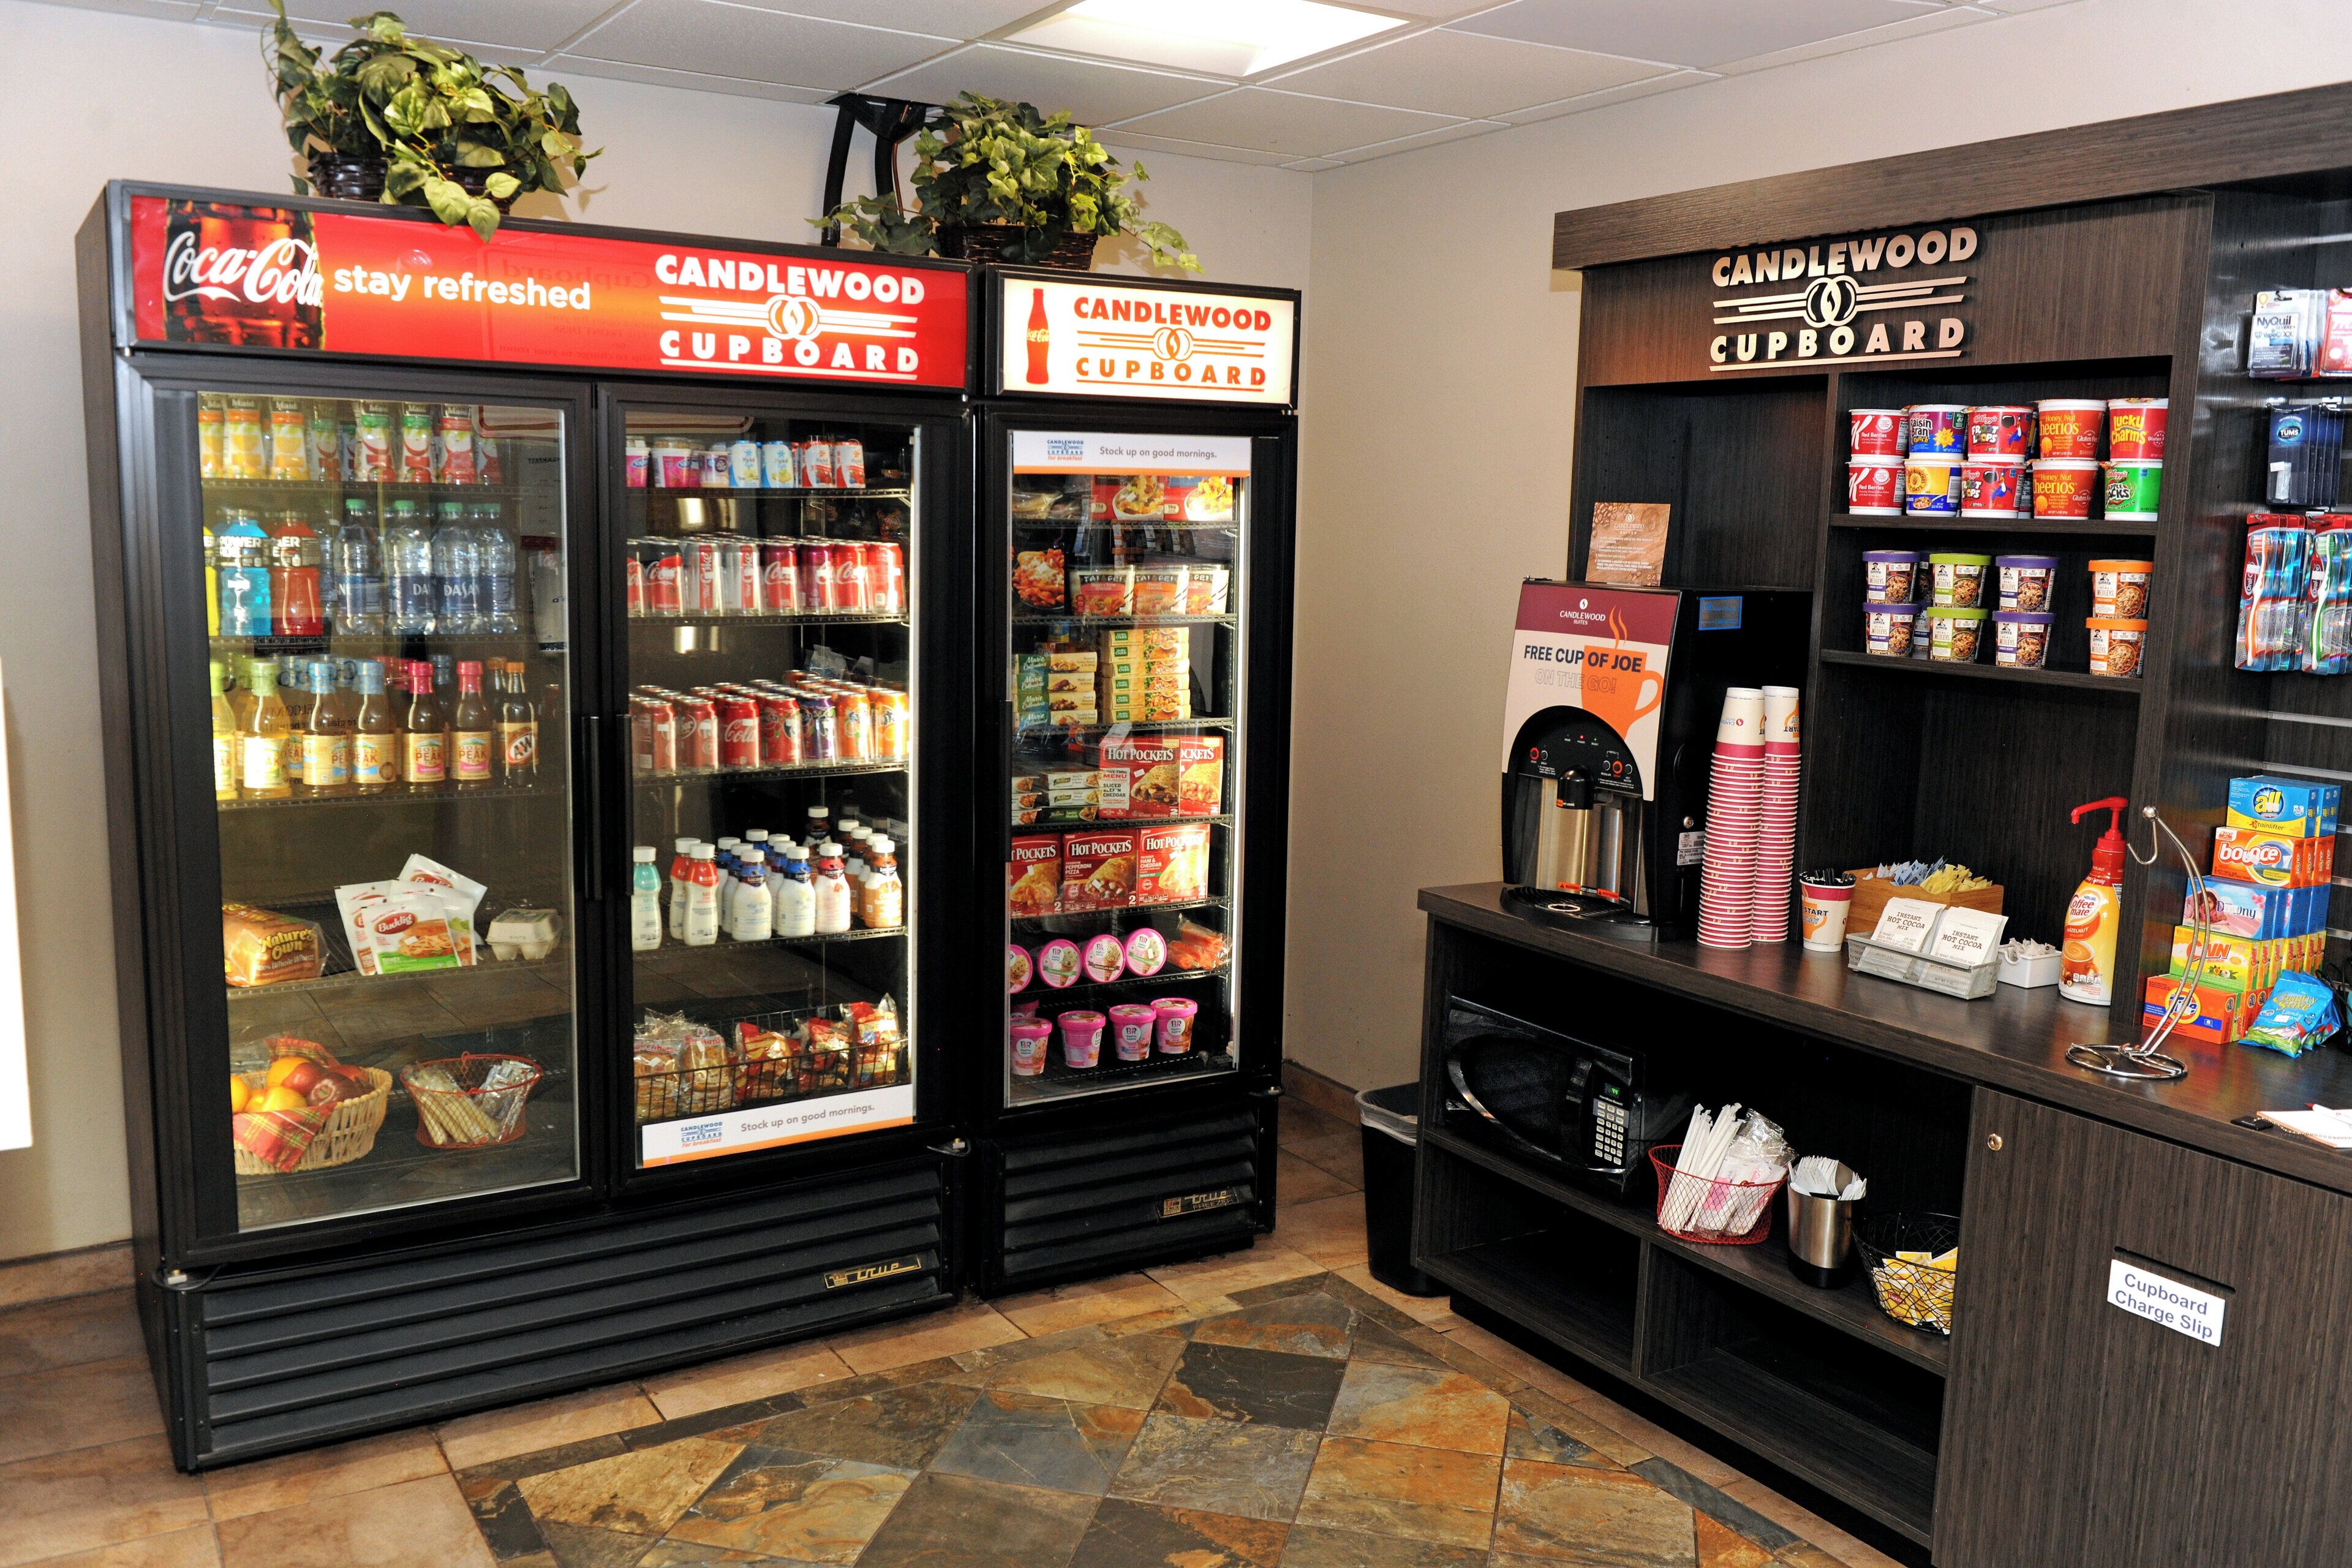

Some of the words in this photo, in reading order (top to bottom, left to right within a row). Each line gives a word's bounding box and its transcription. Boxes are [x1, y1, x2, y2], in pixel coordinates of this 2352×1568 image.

[1713, 227, 1977, 287] CANDLEWOOD
[162, 231, 324, 307] Coca-Cola
[655, 254, 925, 305] CANDLEWOOD
[334, 264, 412, 301] stay
[423, 272, 590, 311] refreshed
[1074, 297, 1271, 331] CANDLEWOOD
[2257, 316, 2291, 328] NyQuil
[1710, 317, 1964, 363] CUPBOARD
[659, 330, 919, 372] CUPBOARD
[1076, 357, 1266, 385] CUPBOARD
[1910, 419, 1931, 428] Raisin
[1973, 414, 1997, 424] Kellogg's
[2114, 415, 2144, 431] LUCKY
[2111, 429, 2147, 445] Charms
[1100, 447, 1123, 456] Stock
[1125, 448, 1137, 458] up
[1153, 448, 1174, 459] good
[1177, 449, 1217, 459] mornings.
[1560, 611, 1605, 621] CANDLEWOOD
[1524, 645, 1553, 661] FREE
[1556, 649, 1584, 664] CUP
[1588, 652, 1608, 667] OF
[1611, 654, 1642, 673] JOE
[1536, 668, 1554, 685] ON
[1558, 671, 1583, 688] THE
[1588, 676, 1616, 693] GO!
[416, 752, 443, 761] PEAK
[459, 750, 486, 760] PEAK
[1108, 748, 1130, 760] HOT
[1130, 748, 1174, 760] POCKETS
[2255, 791, 2282, 812] all
[2254, 821, 2284, 831] stainlifter
[1072, 843, 1090, 856] HOT
[1091, 841, 1131, 854] POCKETS
[1147, 839, 1164, 850] HOT
[1016, 846, 1056, 859] POCKETS
[1055, 902, 1062, 911] 2
[1129, 896, 1136, 905] 2
[2070, 895, 2094, 909] Coffee
[1804, 907, 1828, 916] START
[1897, 912, 1921, 921] INSTANT
[379, 915, 413, 933] Buddig
[1903, 920, 1925, 929] COCOA
[258, 929, 314, 952] Nature's
[1953, 931, 1978, 940] INSTANT
[272, 941, 303, 960] Own
[1958, 940, 1982, 949] COCOA
[272, 959, 293, 969] Whole
[294, 954, 314, 963] Wheat
[2273, 992, 2319, 1004] Country
[741, 1120, 768, 1132] Stock
[771, 1118, 783, 1128] up
[802, 1110, 826, 1123] good
[829, 1104, 875, 1118] mornings.
[680, 1122, 723, 1131] CANDLEWOOD
[2125, 1274, 2207, 1315] Cupboard
[2116, 1291, 2174, 1323] Charge
[2180, 1314, 2212, 1339] Slip
